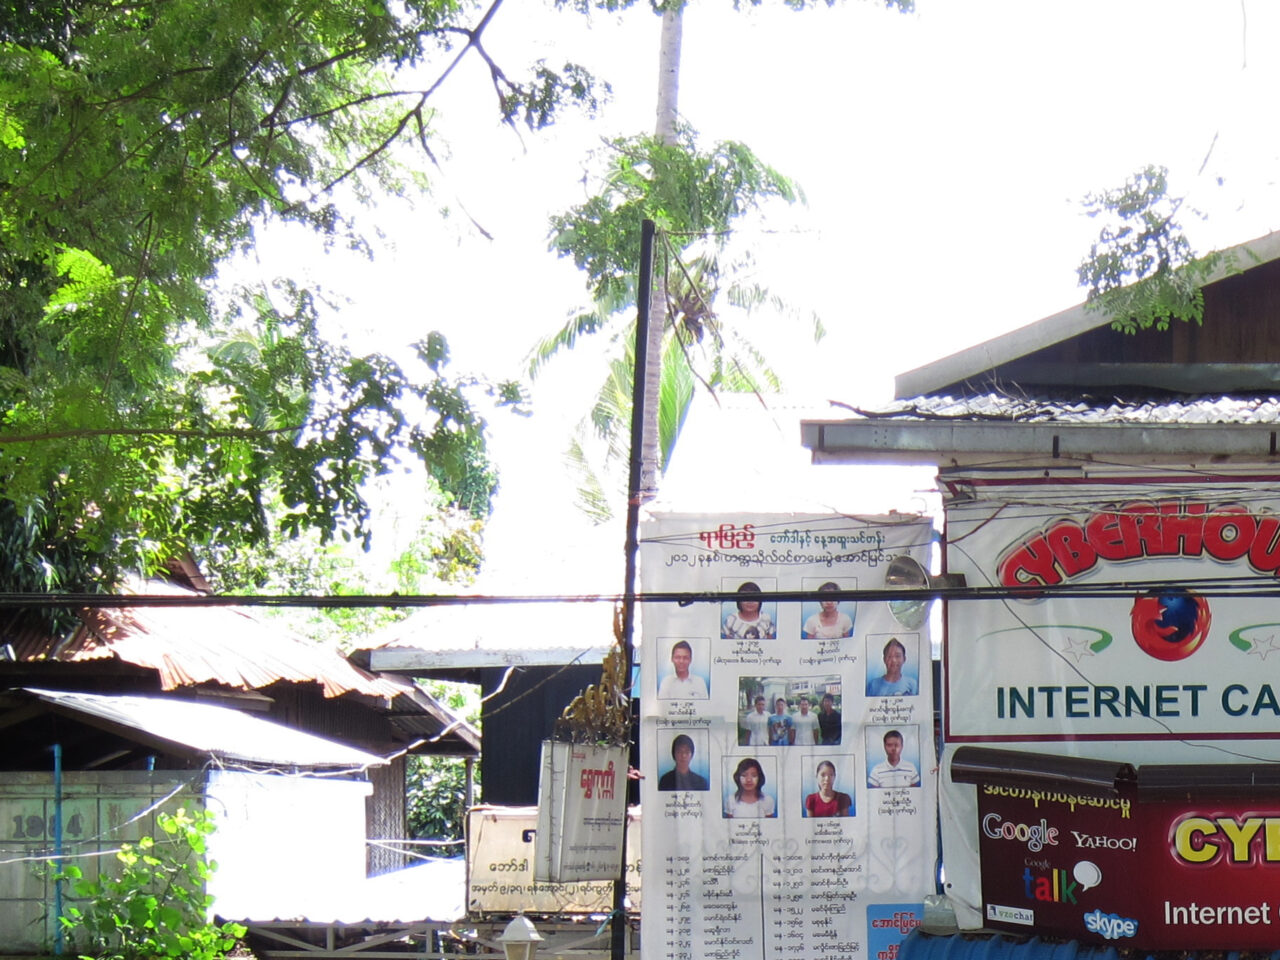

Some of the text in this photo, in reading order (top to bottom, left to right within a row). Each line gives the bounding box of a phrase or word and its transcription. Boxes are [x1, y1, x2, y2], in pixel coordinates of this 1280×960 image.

[997, 684, 1207, 719] INTERNET
[983, 813, 1059, 852] Google
[1023, 867, 1078, 905] talk
[1087, 911, 1135, 938] skype
[1164, 900, 1271, 925] Internet
